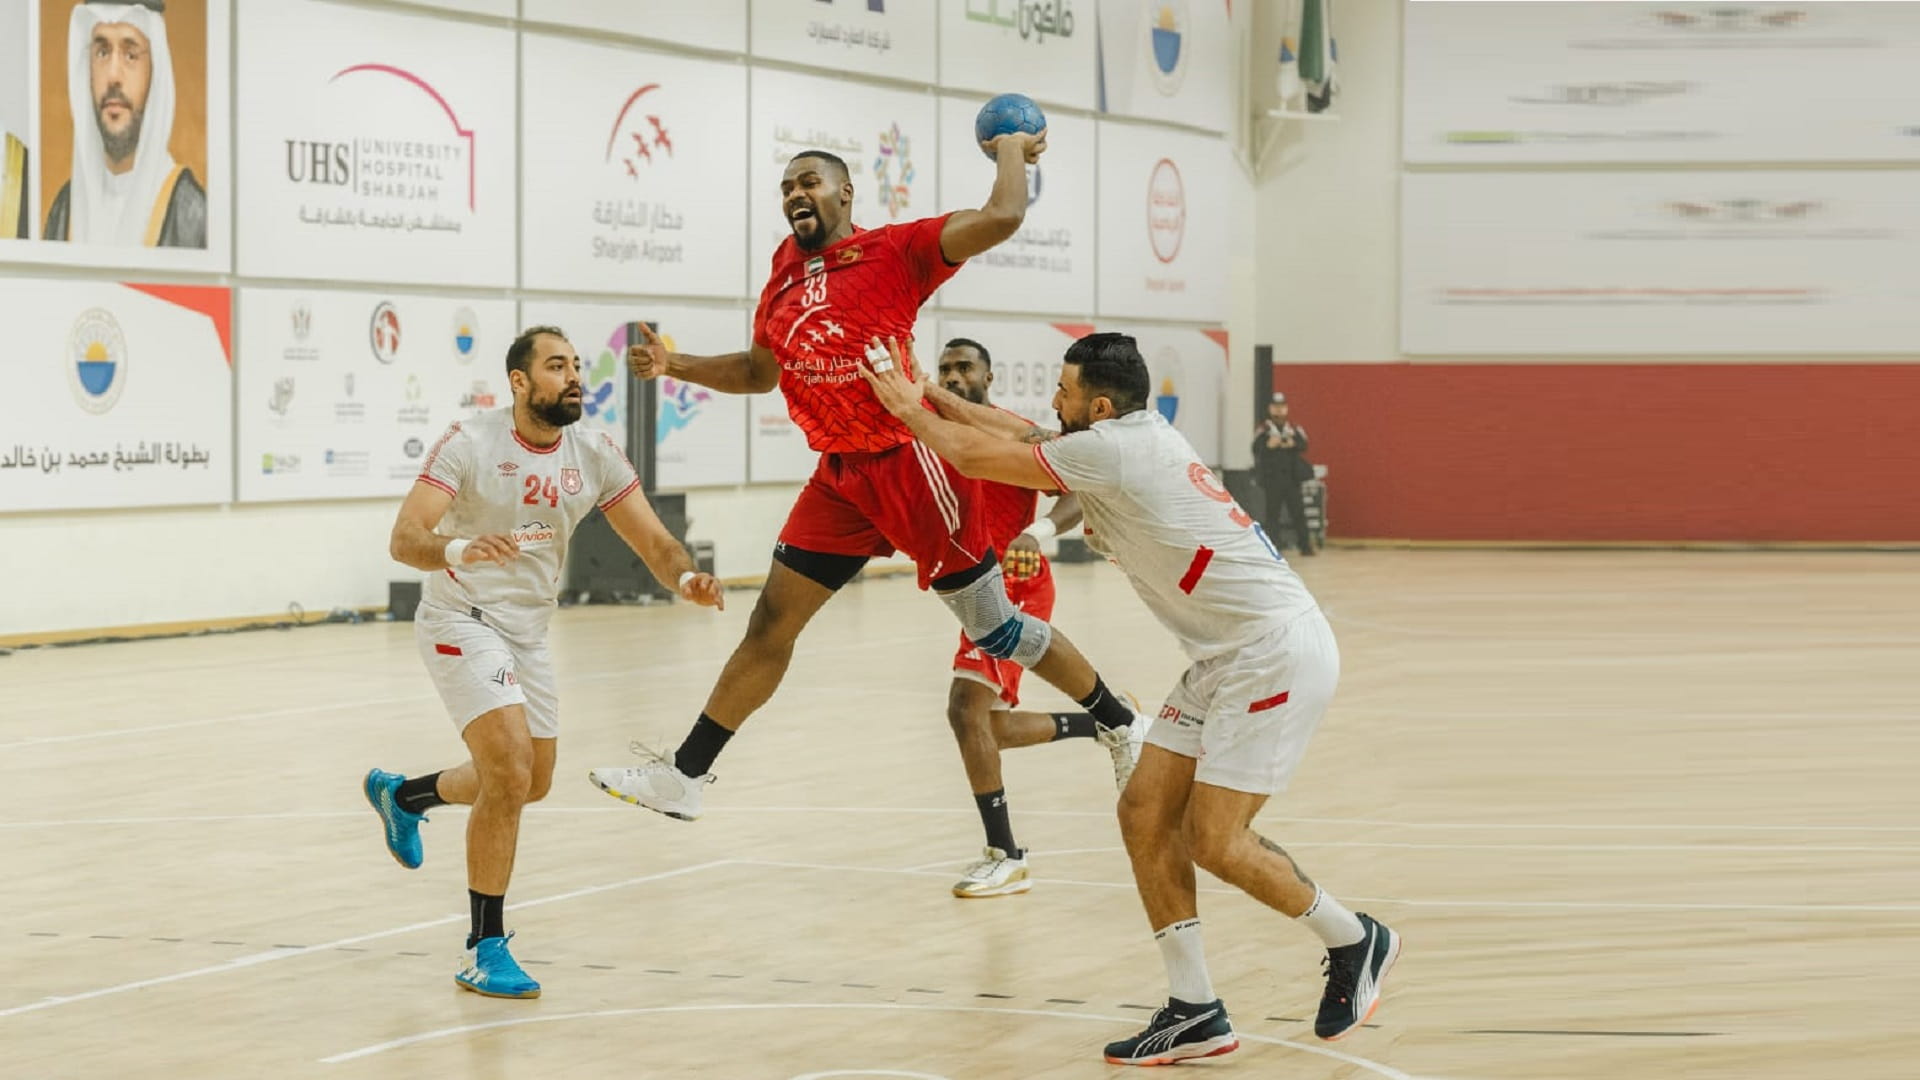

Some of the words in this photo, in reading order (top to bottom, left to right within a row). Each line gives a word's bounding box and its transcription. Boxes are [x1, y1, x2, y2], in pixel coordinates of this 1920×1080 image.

[285, 140, 350, 186] UHS
[361, 138, 462, 162] UNIVERSITY
[361, 159, 443, 182] HOSPITAL
[361, 180, 439, 202] SHARJAH
[592, 200, 645, 232] الشارقة
[592, 235, 637, 265] Sharjah
[639, 238, 683, 265] Airport
[801, 272, 828, 307] 33
[1, 444, 37, 469] خالد
[41, 445, 62, 475] بن
[68, 450, 109, 468] محمد
[113, 440, 161, 472] الشيخ
[165, 441, 210, 470] بطولة
[523, 474, 559, 508] 24
[513, 529, 554, 545] Vivian
[1158, 703, 1182, 724] EPI
